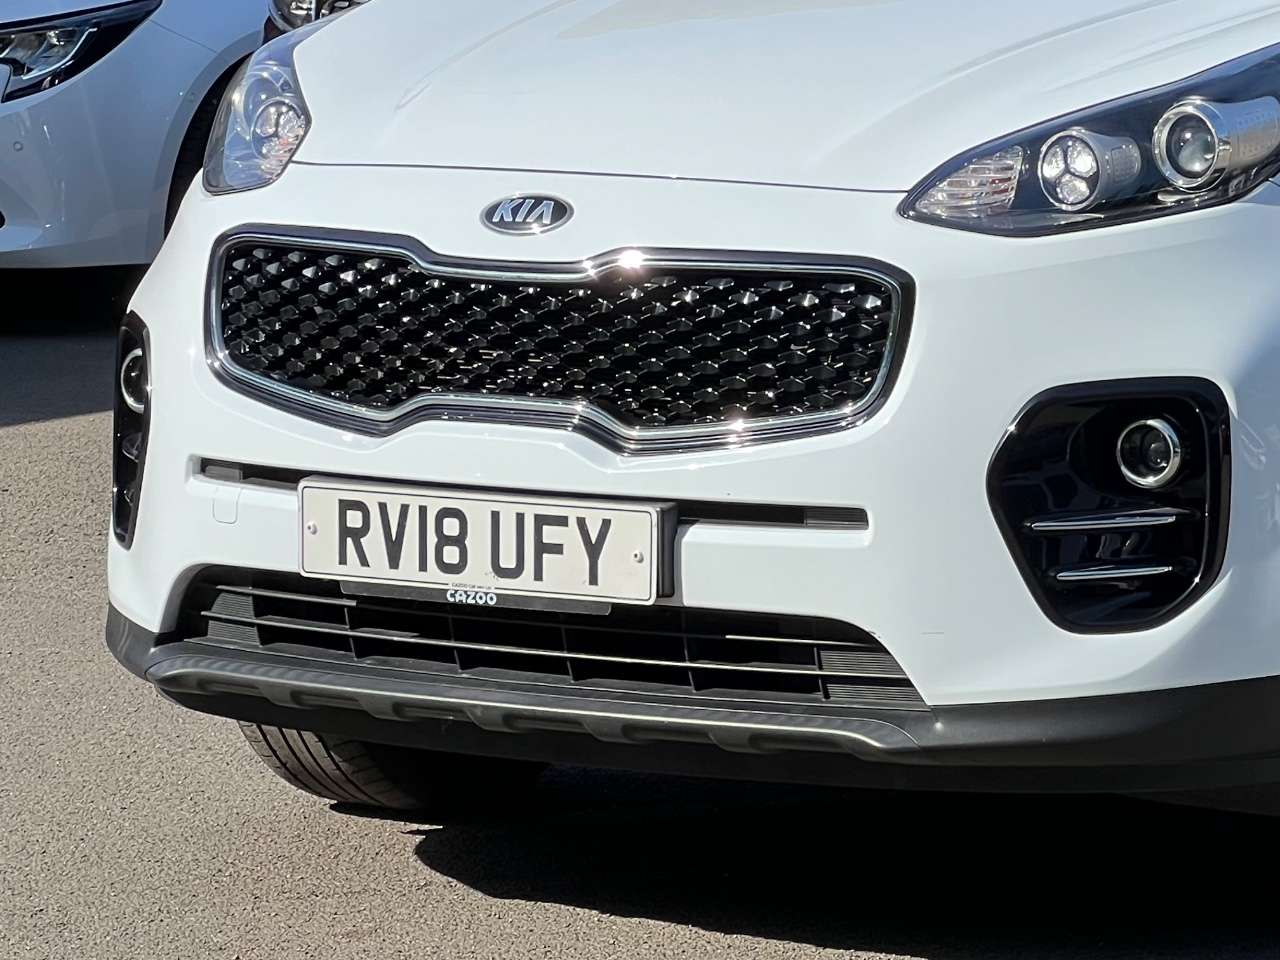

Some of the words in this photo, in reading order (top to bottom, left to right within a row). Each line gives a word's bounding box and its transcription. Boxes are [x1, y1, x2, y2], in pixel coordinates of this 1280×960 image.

[492, 199, 554, 224] KIA
[338, 499, 468, 575] RV18
[490, 510, 612, 586] UFY
[446, 589, 497, 605] CAZOO
